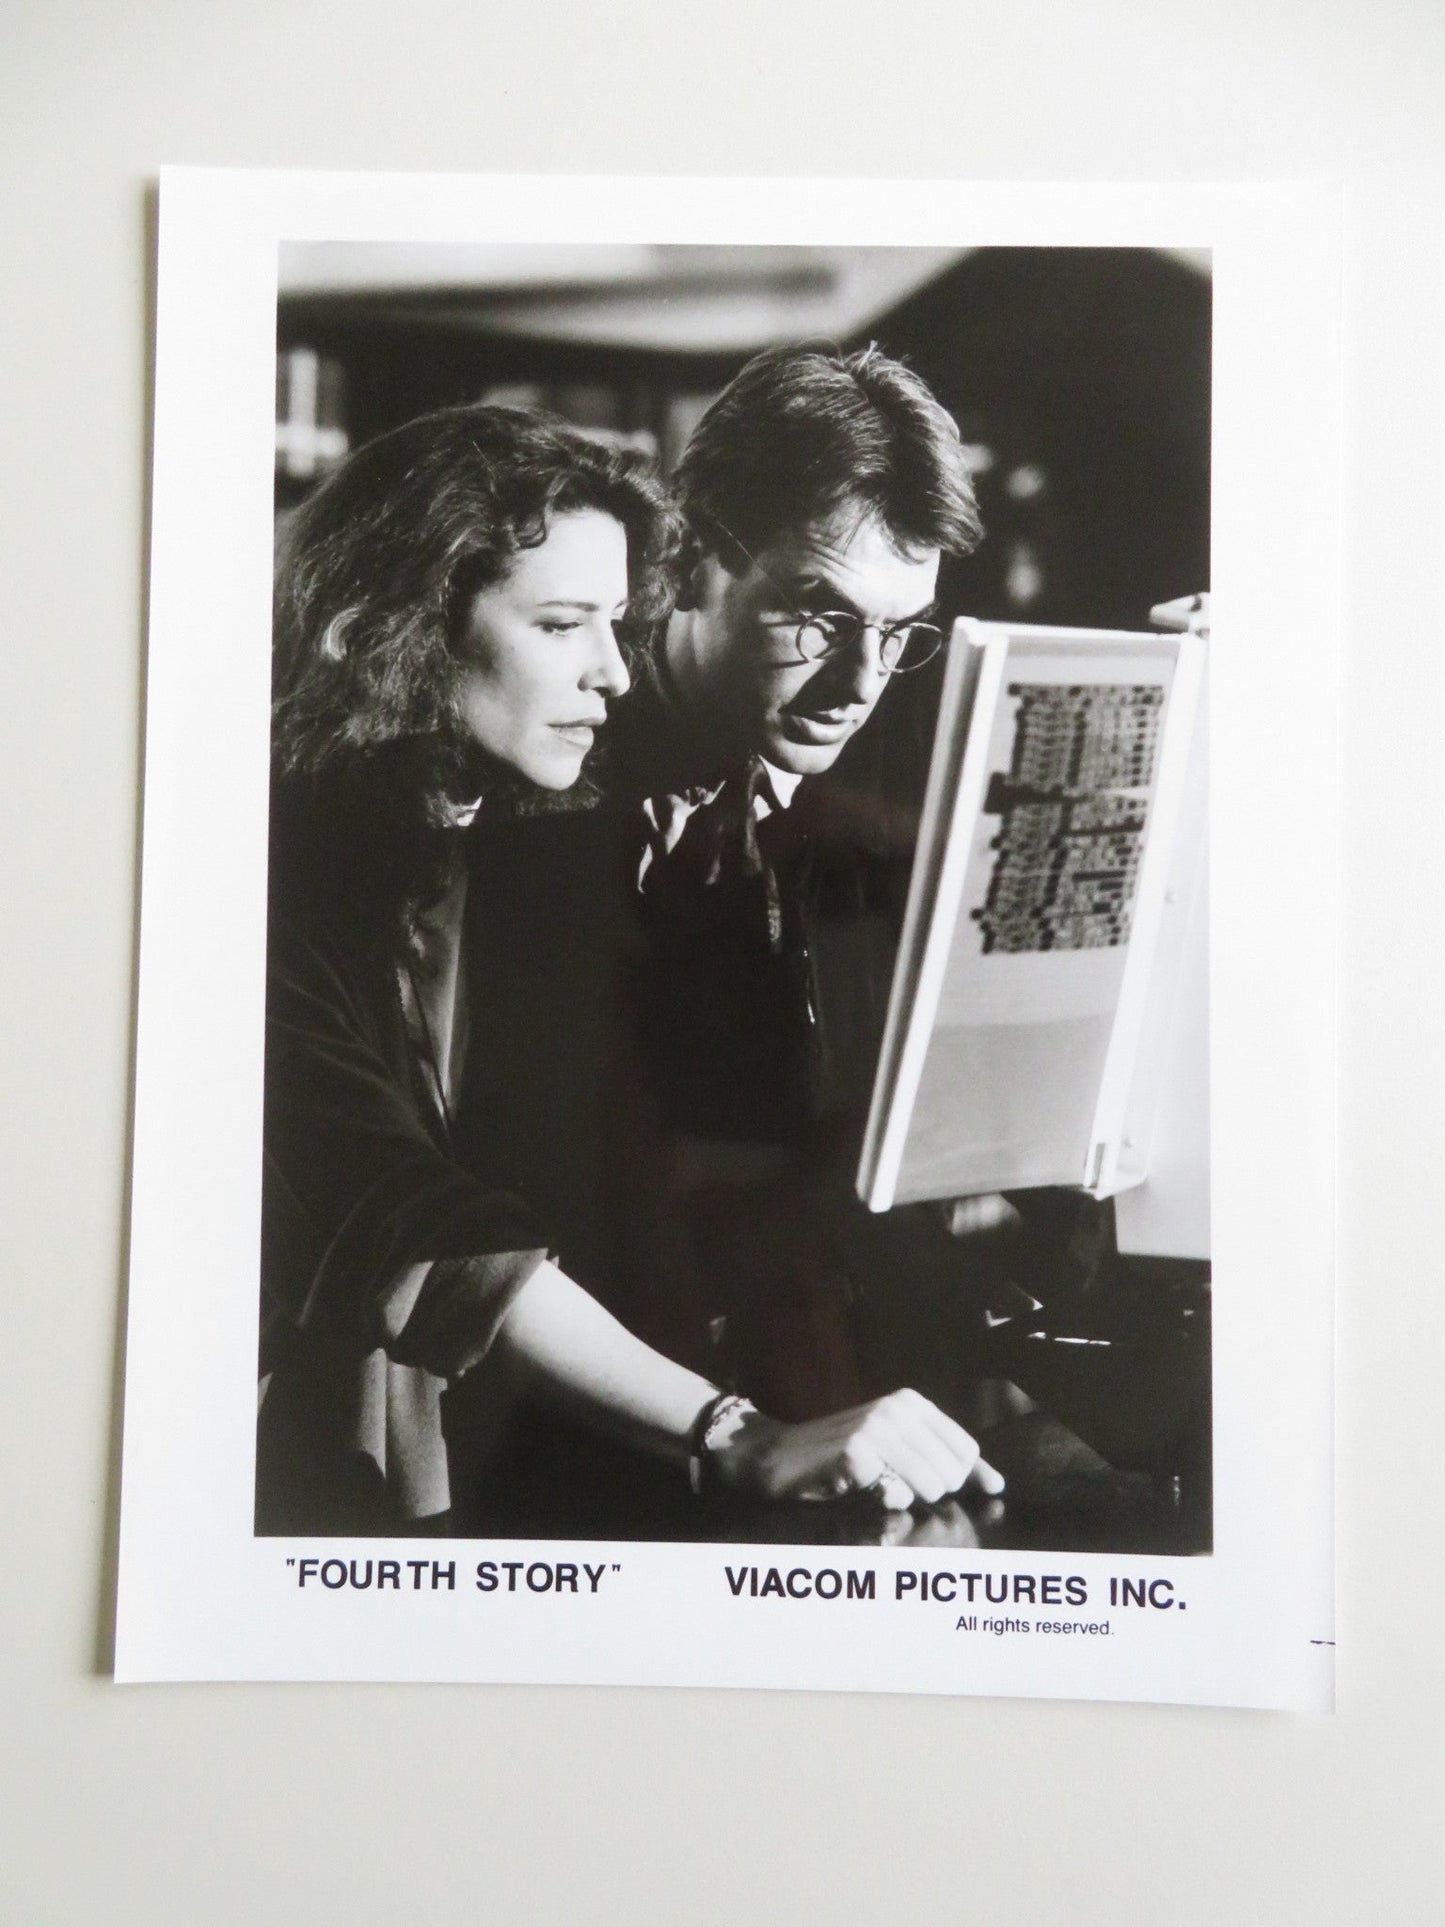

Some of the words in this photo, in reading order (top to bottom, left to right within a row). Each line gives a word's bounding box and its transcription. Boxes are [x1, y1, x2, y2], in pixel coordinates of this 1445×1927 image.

[286, 1558, 456, 1591] "FOURTH
[475, 1561, 621, 1593] STORY"
[724, 1566, 876, 1600] VIACOM
[895, 1570, 1088, 1606] PICTURES
[1110, 1577, 1186, 1610] INC.
[955, 1615, 978, 1631] All
[983, 1617, 1031, 1636] rights
[1036, 1620, 1117, 1636] reserved.
